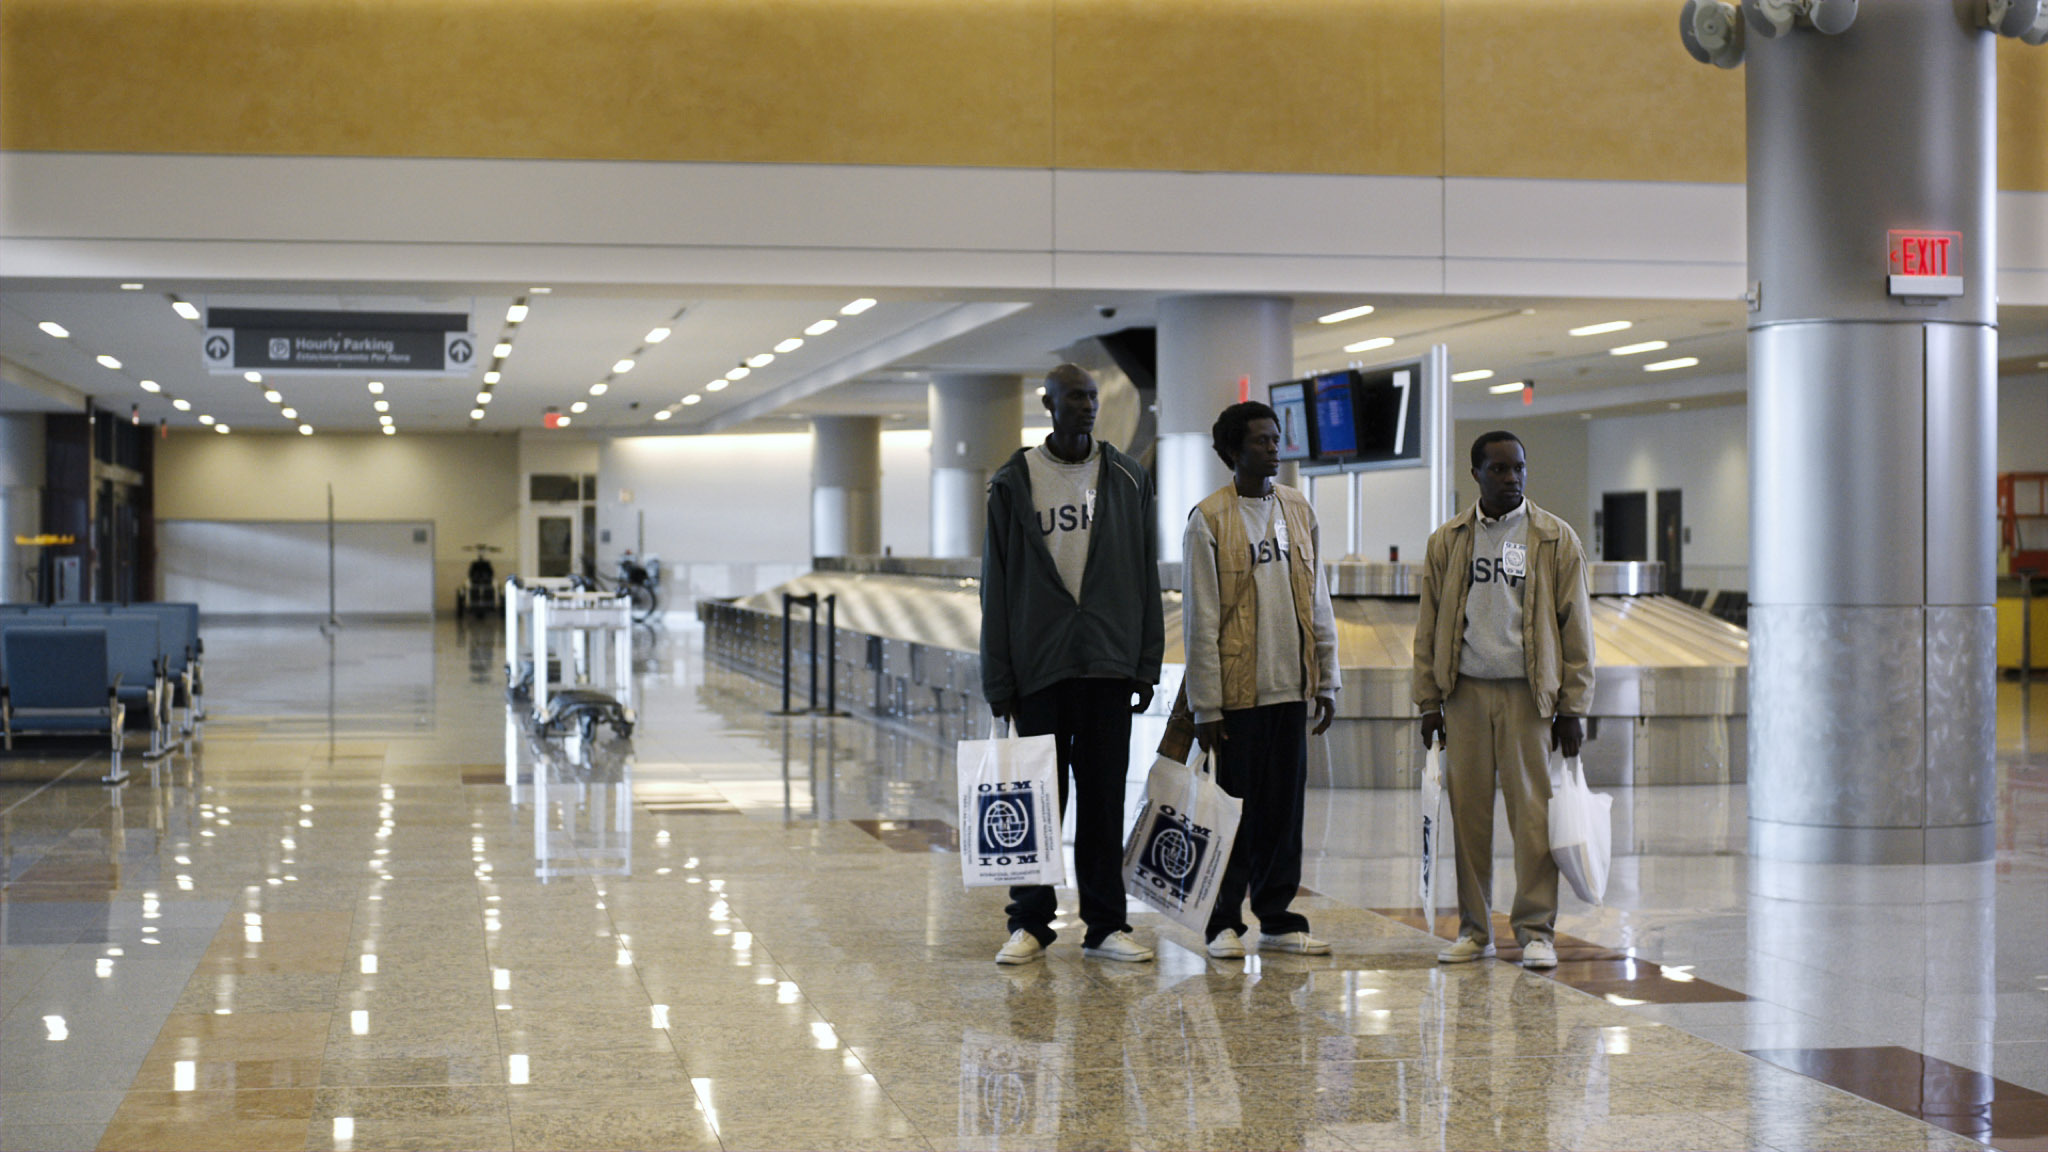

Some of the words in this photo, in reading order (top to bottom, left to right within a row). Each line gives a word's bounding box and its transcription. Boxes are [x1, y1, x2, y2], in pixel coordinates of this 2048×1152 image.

[1902, 237, 1950, 276] EXIT
[295, 337, 339, 352] Hourly
[343, 338, 393, 354] Parking
[1393, 370, 1411, 454] 7
[978, 780, 1032, 793] OIM
[1159, 804, 1212, 838] OIM
[979, 854, 1038, 866] IOM
[1135, 866, 1188, 903] IOM
